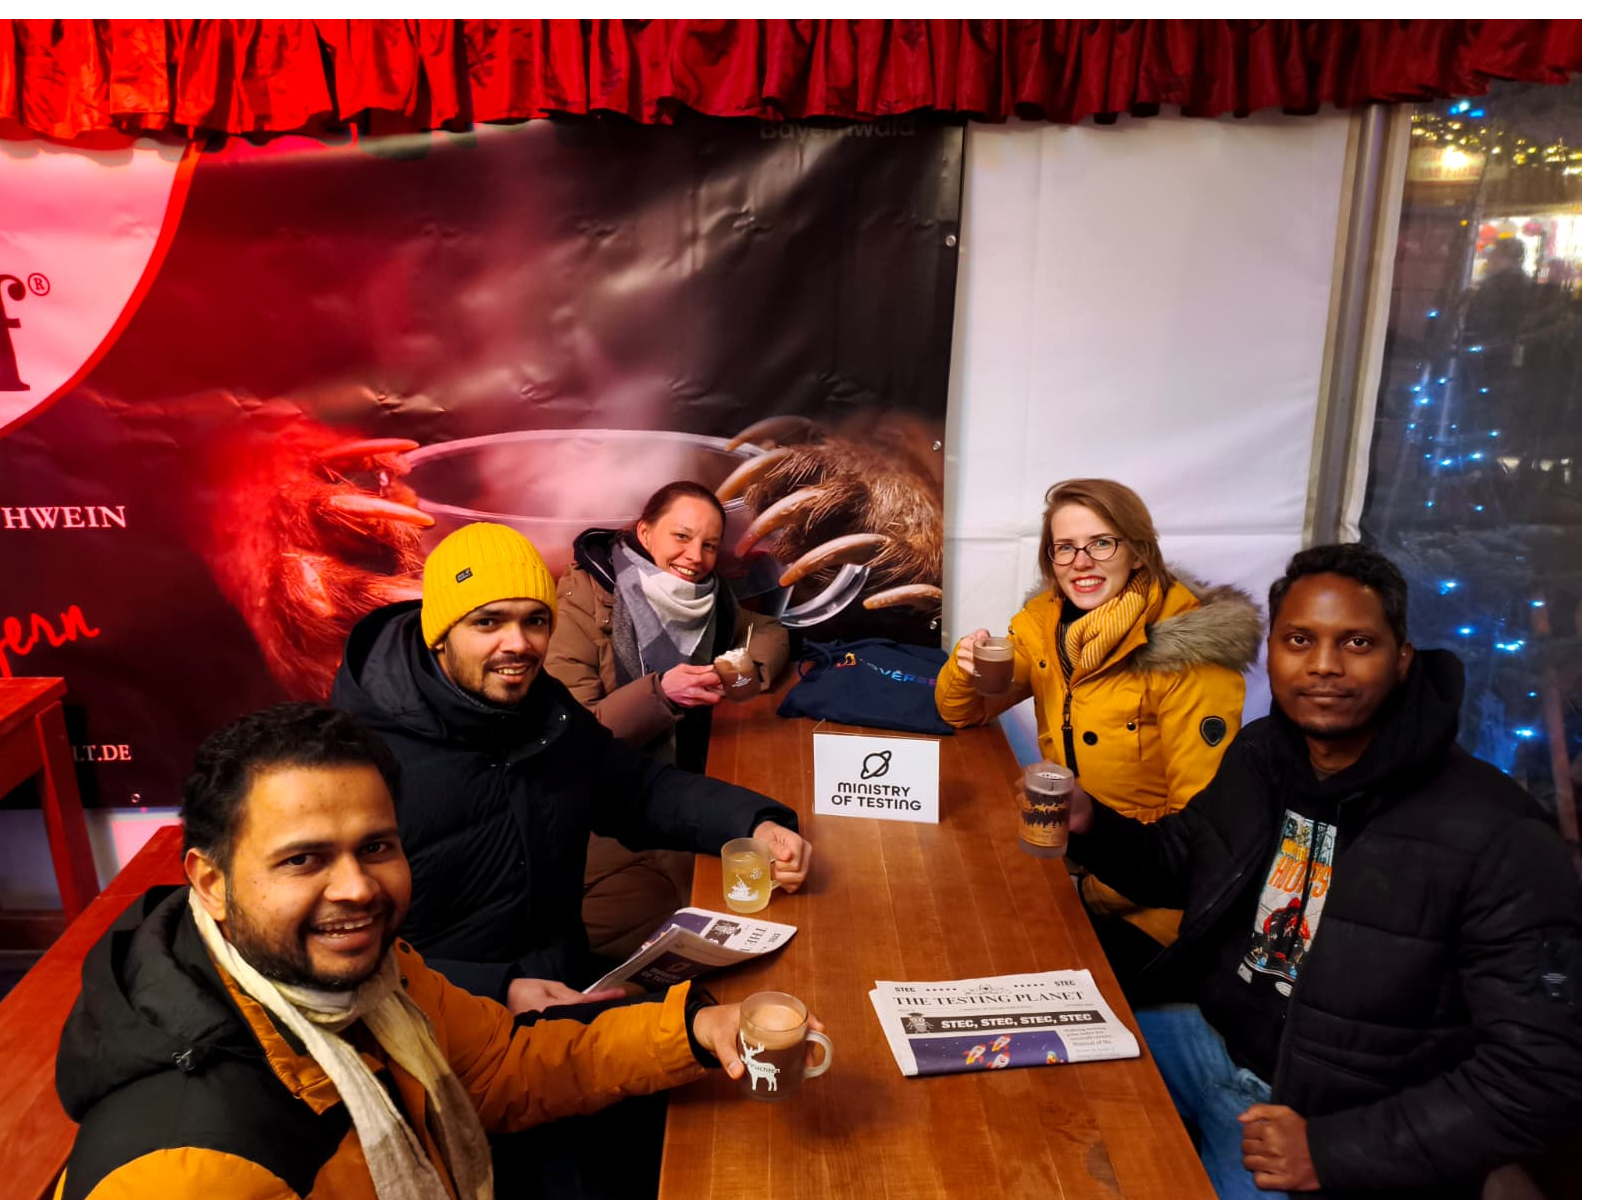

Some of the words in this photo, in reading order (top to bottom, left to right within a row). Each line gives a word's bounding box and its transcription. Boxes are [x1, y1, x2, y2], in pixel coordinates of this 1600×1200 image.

[837, 782, 911, 797] MINISTRY
[831, 795, 853, 806] OF
[857, 796, 922, 811] TESTING
[893, 996, 932, 1006] THE
[933, 993, 1011, 1006] TESTING
[1014, 990, 1085, 1003] PLANET
[941, 1018, 979, 1029] STEC,
[981, 1016, 1018, 1027] STEC,
[1020, 1014, 1058, 1025] STEC,
[1059, 1012, 1093, 1022] STEC
